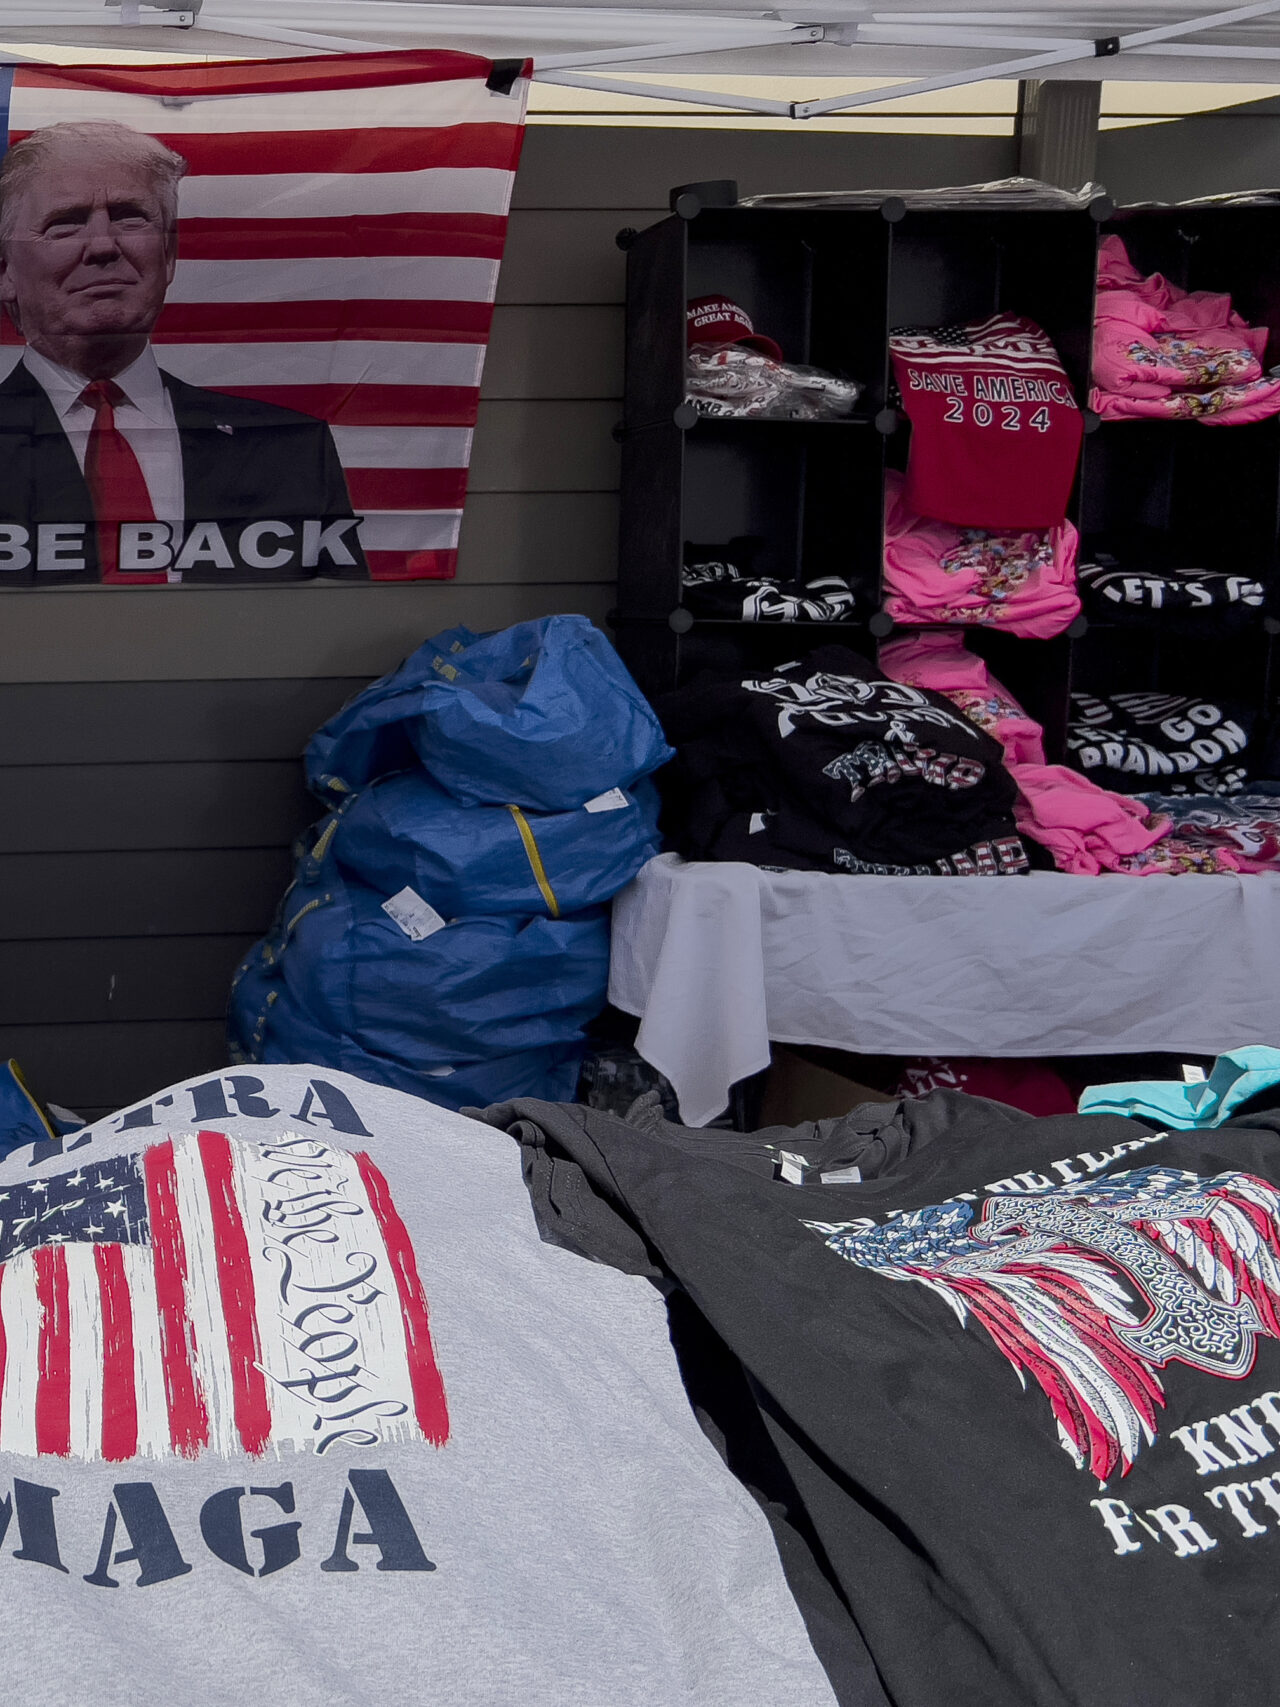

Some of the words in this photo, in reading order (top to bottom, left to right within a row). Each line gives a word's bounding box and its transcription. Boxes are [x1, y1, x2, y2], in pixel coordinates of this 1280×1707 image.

[686, 303, 720, 320] MAKE
[694, 312, 731, 328] GREAT
[908, 369, 968, 396] SAVE
[974, 375, 1078, 409] AMERICA
[944, 397, 1051, 433] 2024
[121, 517, 365, 572] BACK
[1160, 704, 1222, 742] GO
[257, 1136, 350, 1191] We
[260, 1185, 365, 1247] the
[252, 1245, 409, 1456] People
[1089, 1497, 1218, 1559] FR
